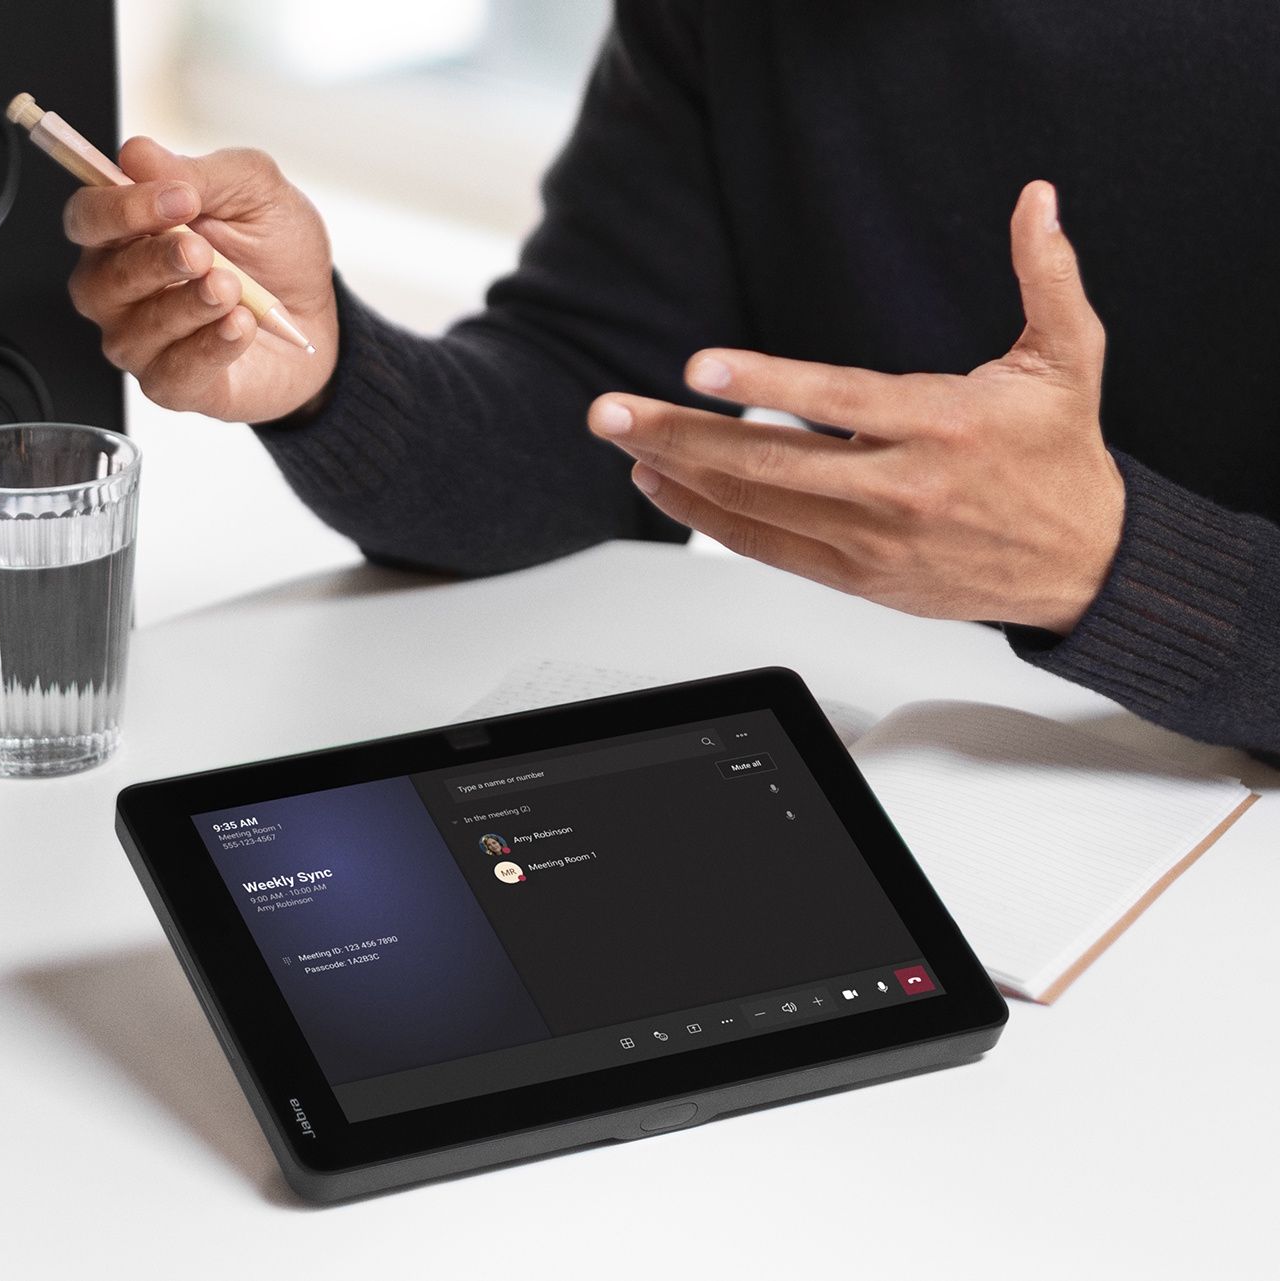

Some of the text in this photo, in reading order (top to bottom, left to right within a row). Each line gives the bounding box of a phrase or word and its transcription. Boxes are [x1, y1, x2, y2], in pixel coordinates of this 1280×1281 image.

[731, 760, 762, 772] Mute all
[457, 784, 476, 794] Type
[484, 778, 506, 788] name
[516, 771, 544, 782] number
[473, 814, 487, 822] the
[488, 808, 519, 819] meeting
[520, 805, 531, 813] (2)
[213, 817, 259, 832] 9:35 AM
[218, 829, 252, 842] Meeting
[252, 825, 277, 835] Room
[222, 833, 276, 850] 555-123-4567
[513, 826, 573, 844] Amy Robinson
[528, 858, 564, 872] Meeting
[564, 853, 591, 864] Room
[242, 868, 333, 893] Weekly Sync
[501, 868, 517, 878] MR
[250, 895, 269, 904] 9:00
[270, 892, 284, 901] AM
[289, 887, 312, 897] 10:00
[313, 883, 327, 892] AM
[256, 896, 314, 913] Amy Robinson
[298, 935, 399, 962] Meeting ID: 123 456 7890
[304, 953, 380, 974] Passcode: 1A2B3C
[290, 1098, 316, 1138] Jabra
